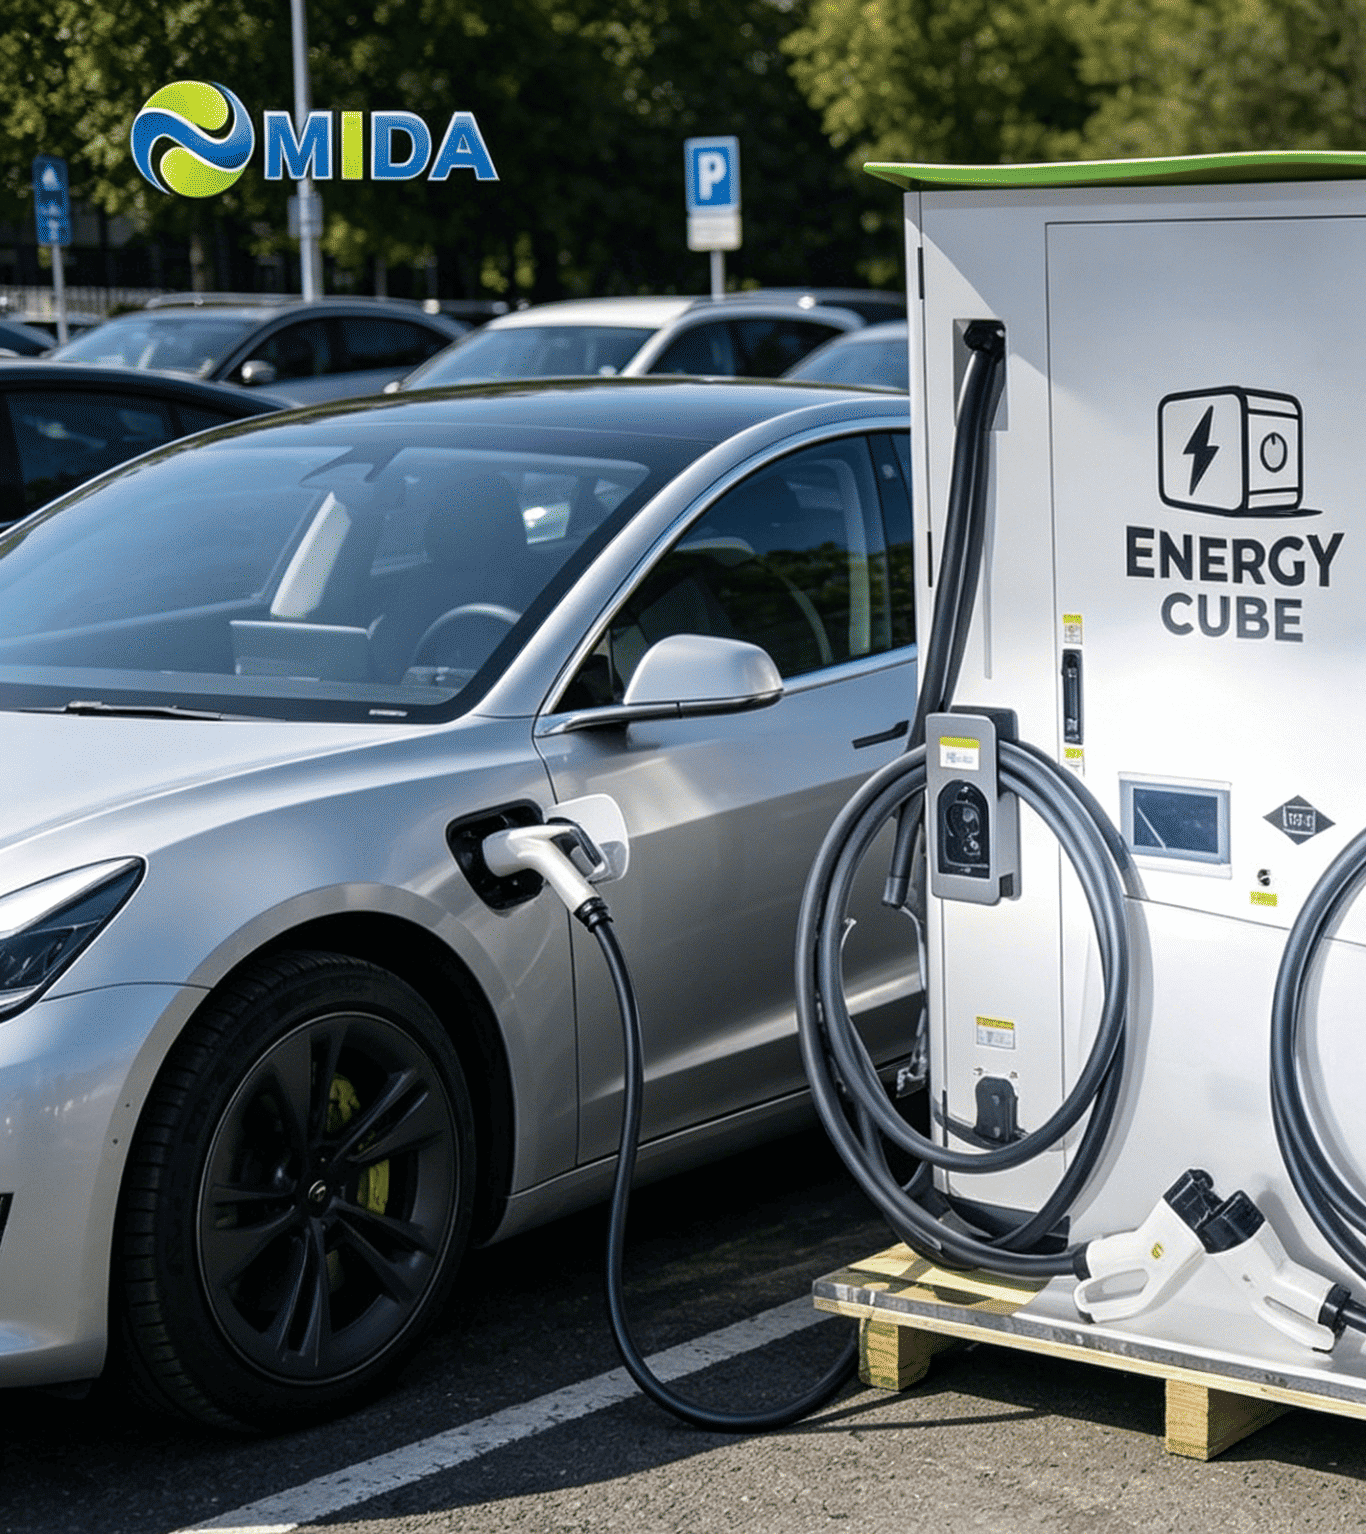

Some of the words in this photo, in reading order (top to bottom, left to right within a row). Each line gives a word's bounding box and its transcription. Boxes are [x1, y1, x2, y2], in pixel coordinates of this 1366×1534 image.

[698, 152, 727, 200] P
[1126, 525, 1345, 588] ENERGY
[1161, 592, 1303, 643] CUBE
